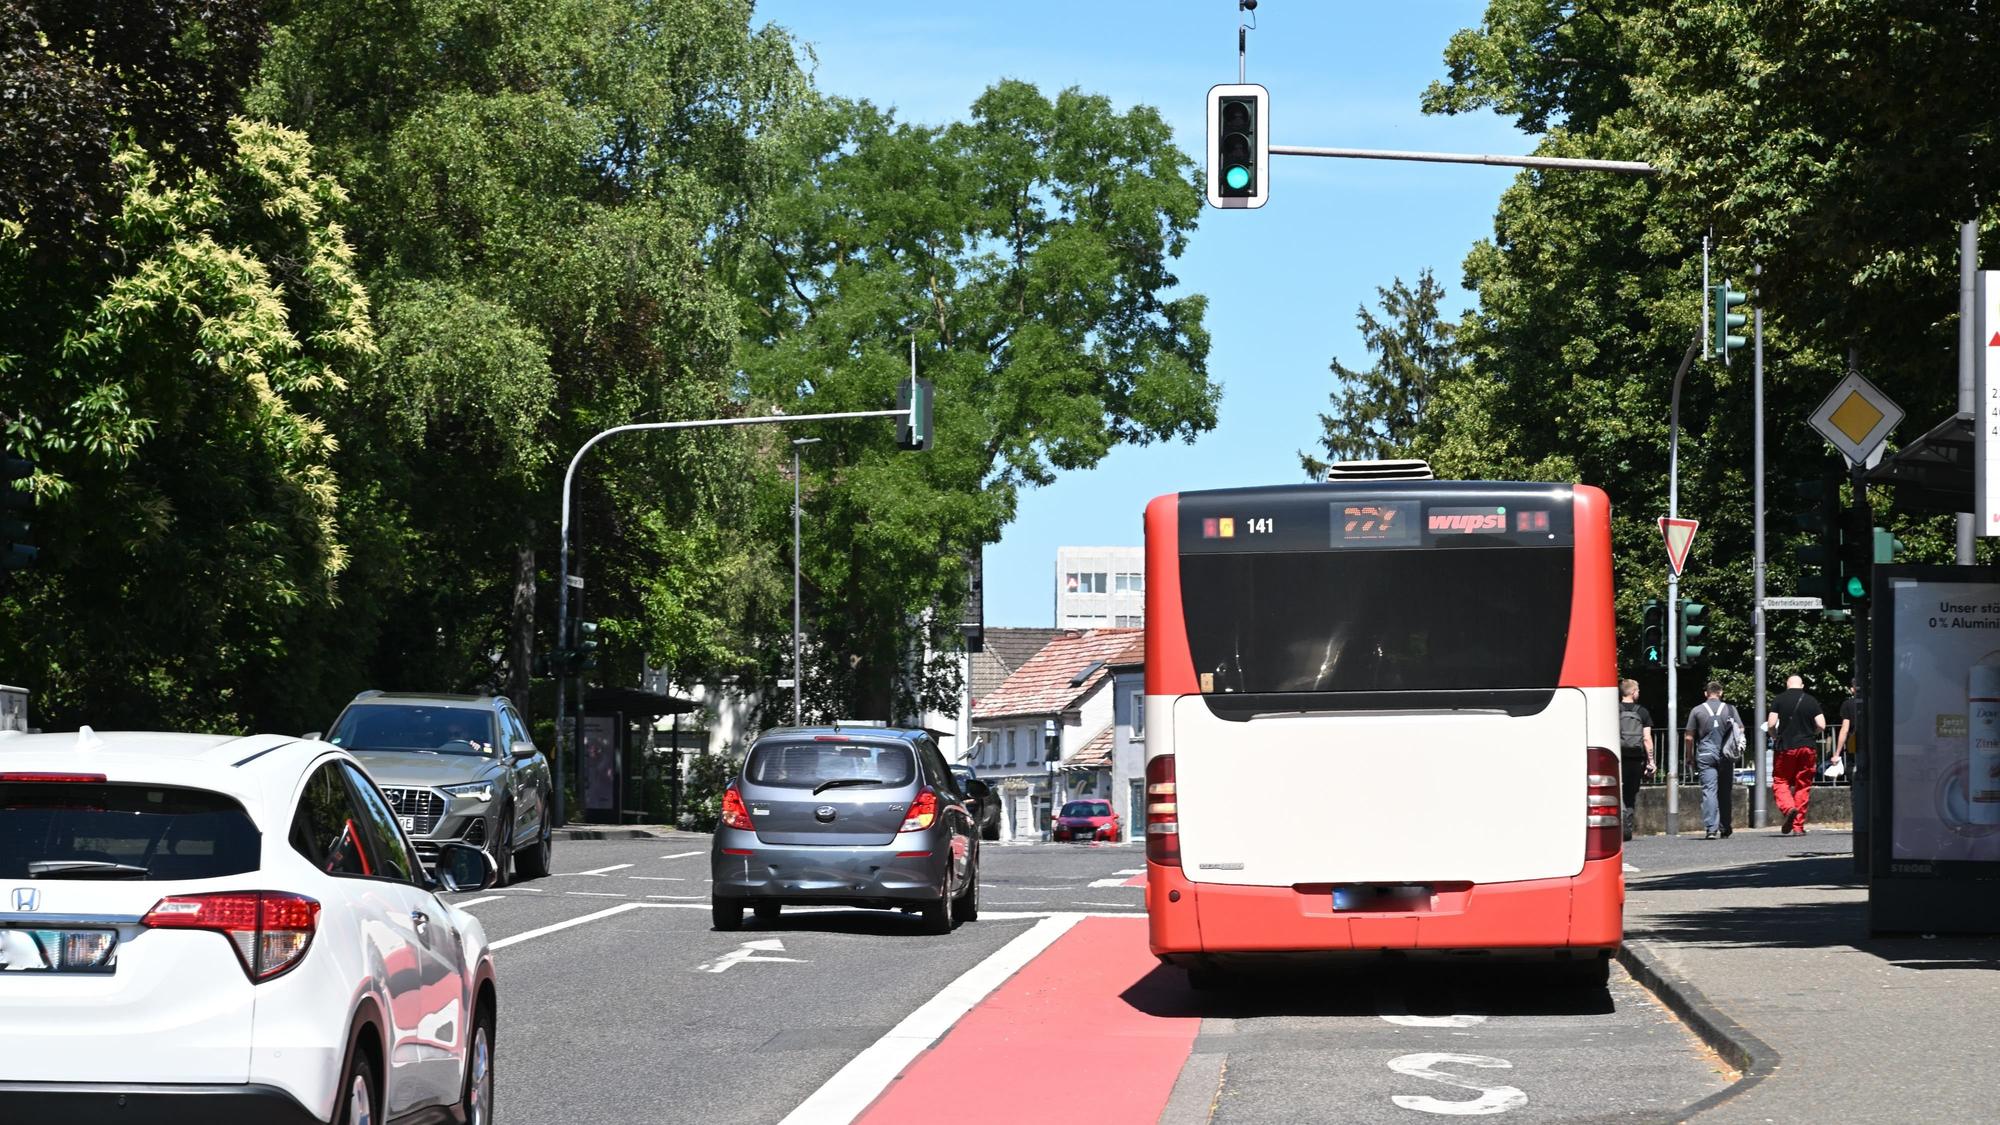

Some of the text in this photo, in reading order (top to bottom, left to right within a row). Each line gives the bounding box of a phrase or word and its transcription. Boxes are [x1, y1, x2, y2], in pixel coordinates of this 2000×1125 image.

[1247, 518, 1273, 533] 141
[1428, 506, 1506, 533] wupsi
[1940, 602, 1977, 613] Unser
[1951, 617, 2000, 629] Alumini
